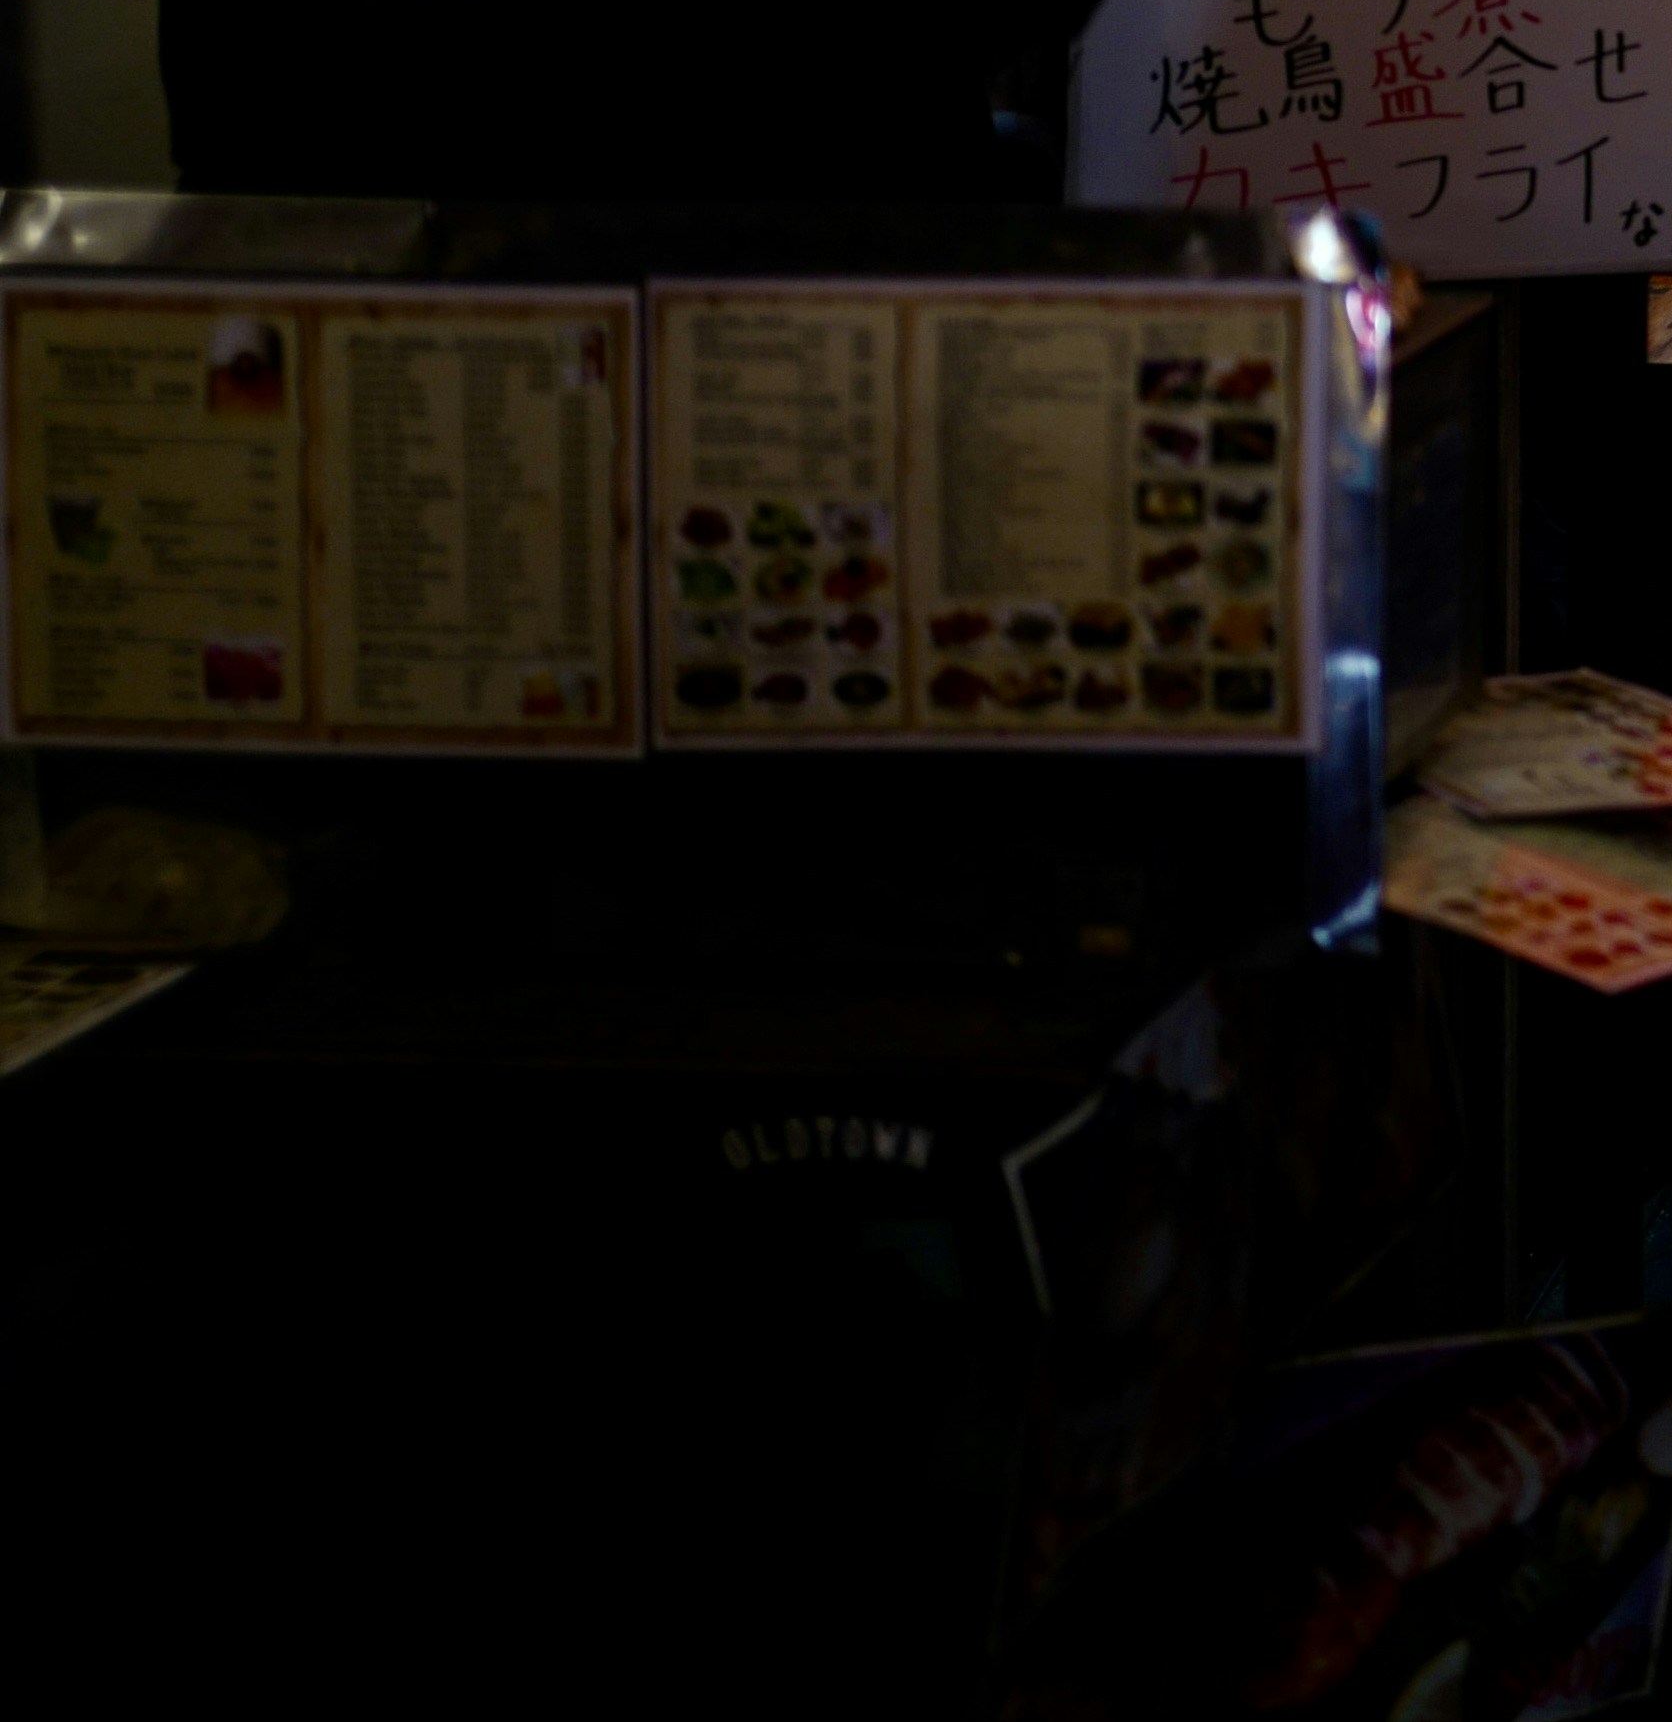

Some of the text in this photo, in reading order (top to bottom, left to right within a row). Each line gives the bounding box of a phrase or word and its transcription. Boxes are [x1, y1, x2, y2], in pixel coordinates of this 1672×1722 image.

[1150, 29, 1648, 136] 焼鳥盛合せ
[1171, 137, 1614, 224] カキフライ
